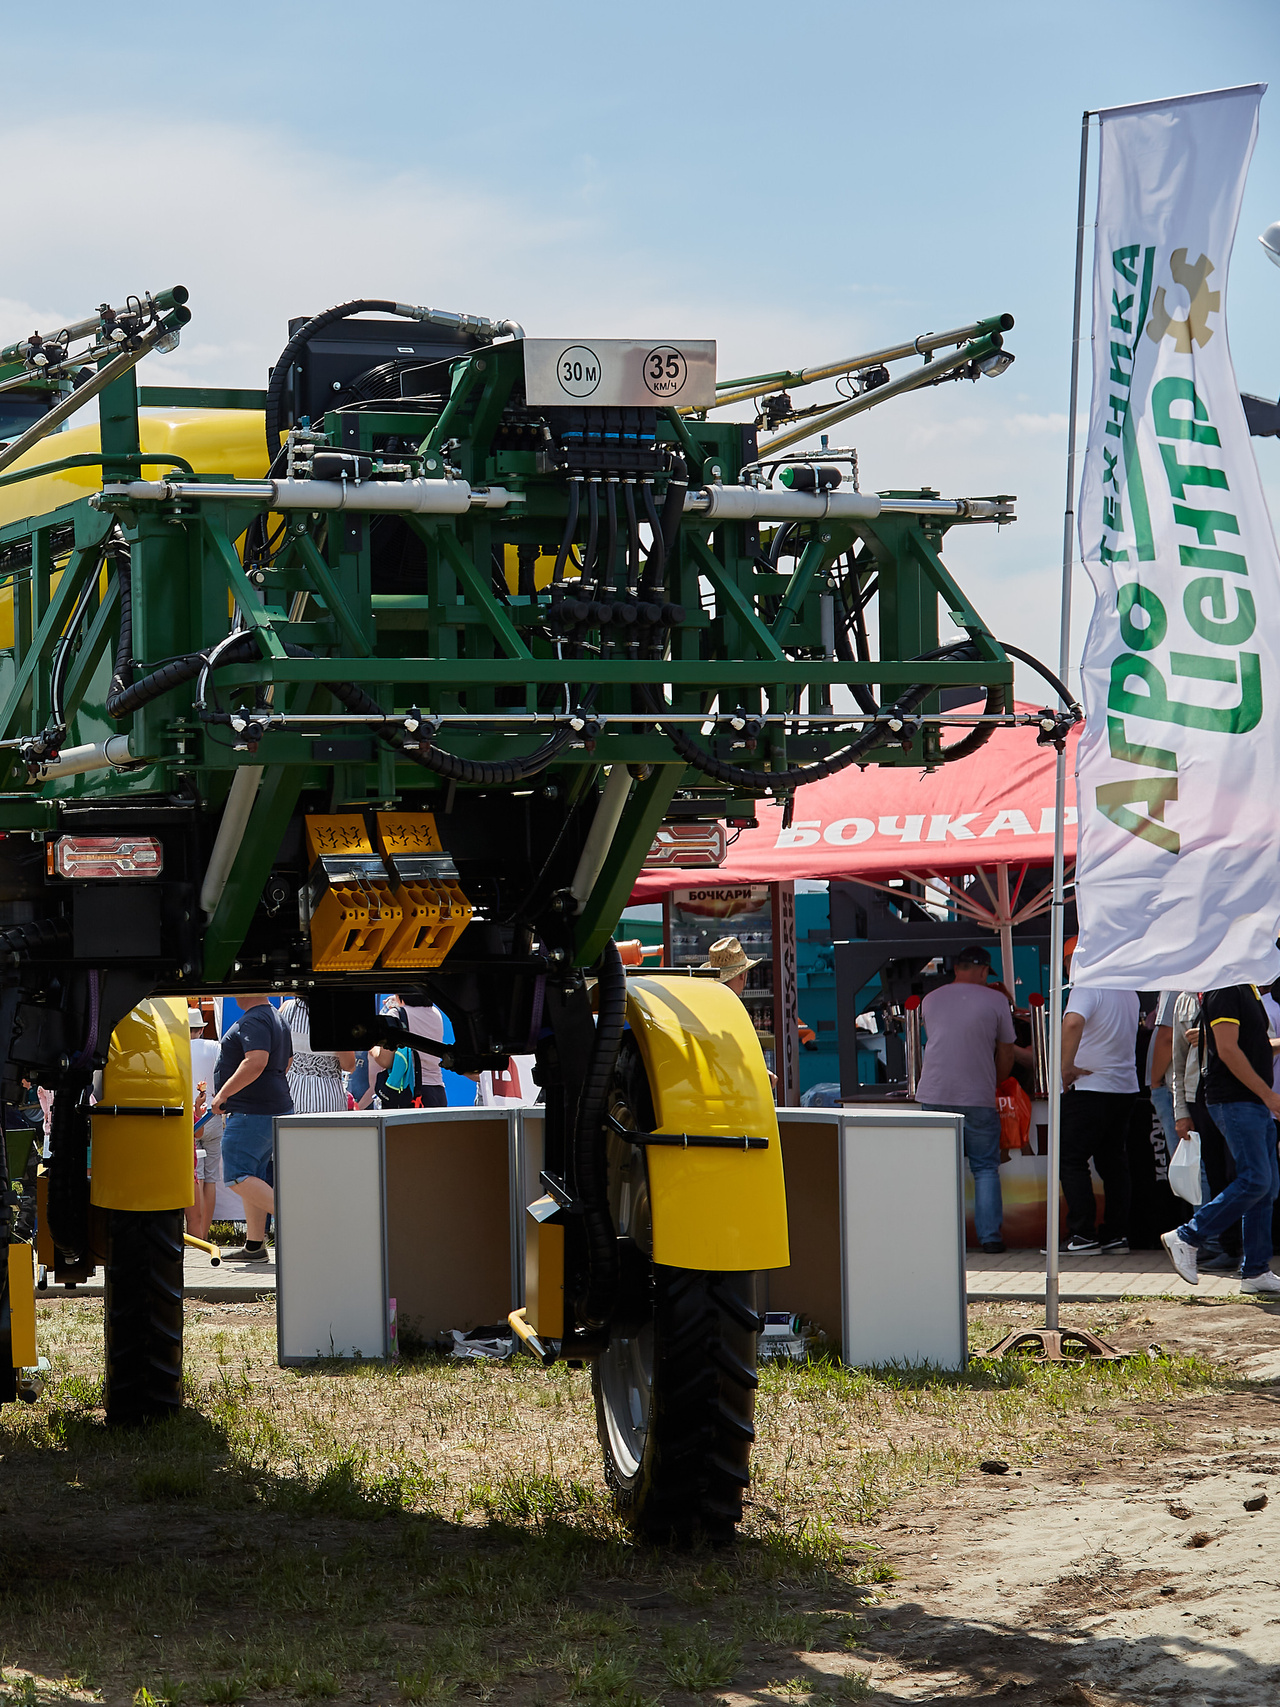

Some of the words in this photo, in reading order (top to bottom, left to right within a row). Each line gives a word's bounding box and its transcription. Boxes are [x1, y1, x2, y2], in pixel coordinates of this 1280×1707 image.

[563, 361, 583, 382] 30
[649, 354, 680, 379] 35
[1099, 243, 1142, 567] ТЕХНИКА
[774, 806, 1078, 849] БОЧКАР
[688, 889, 752, 902] БОЧКАРИ
